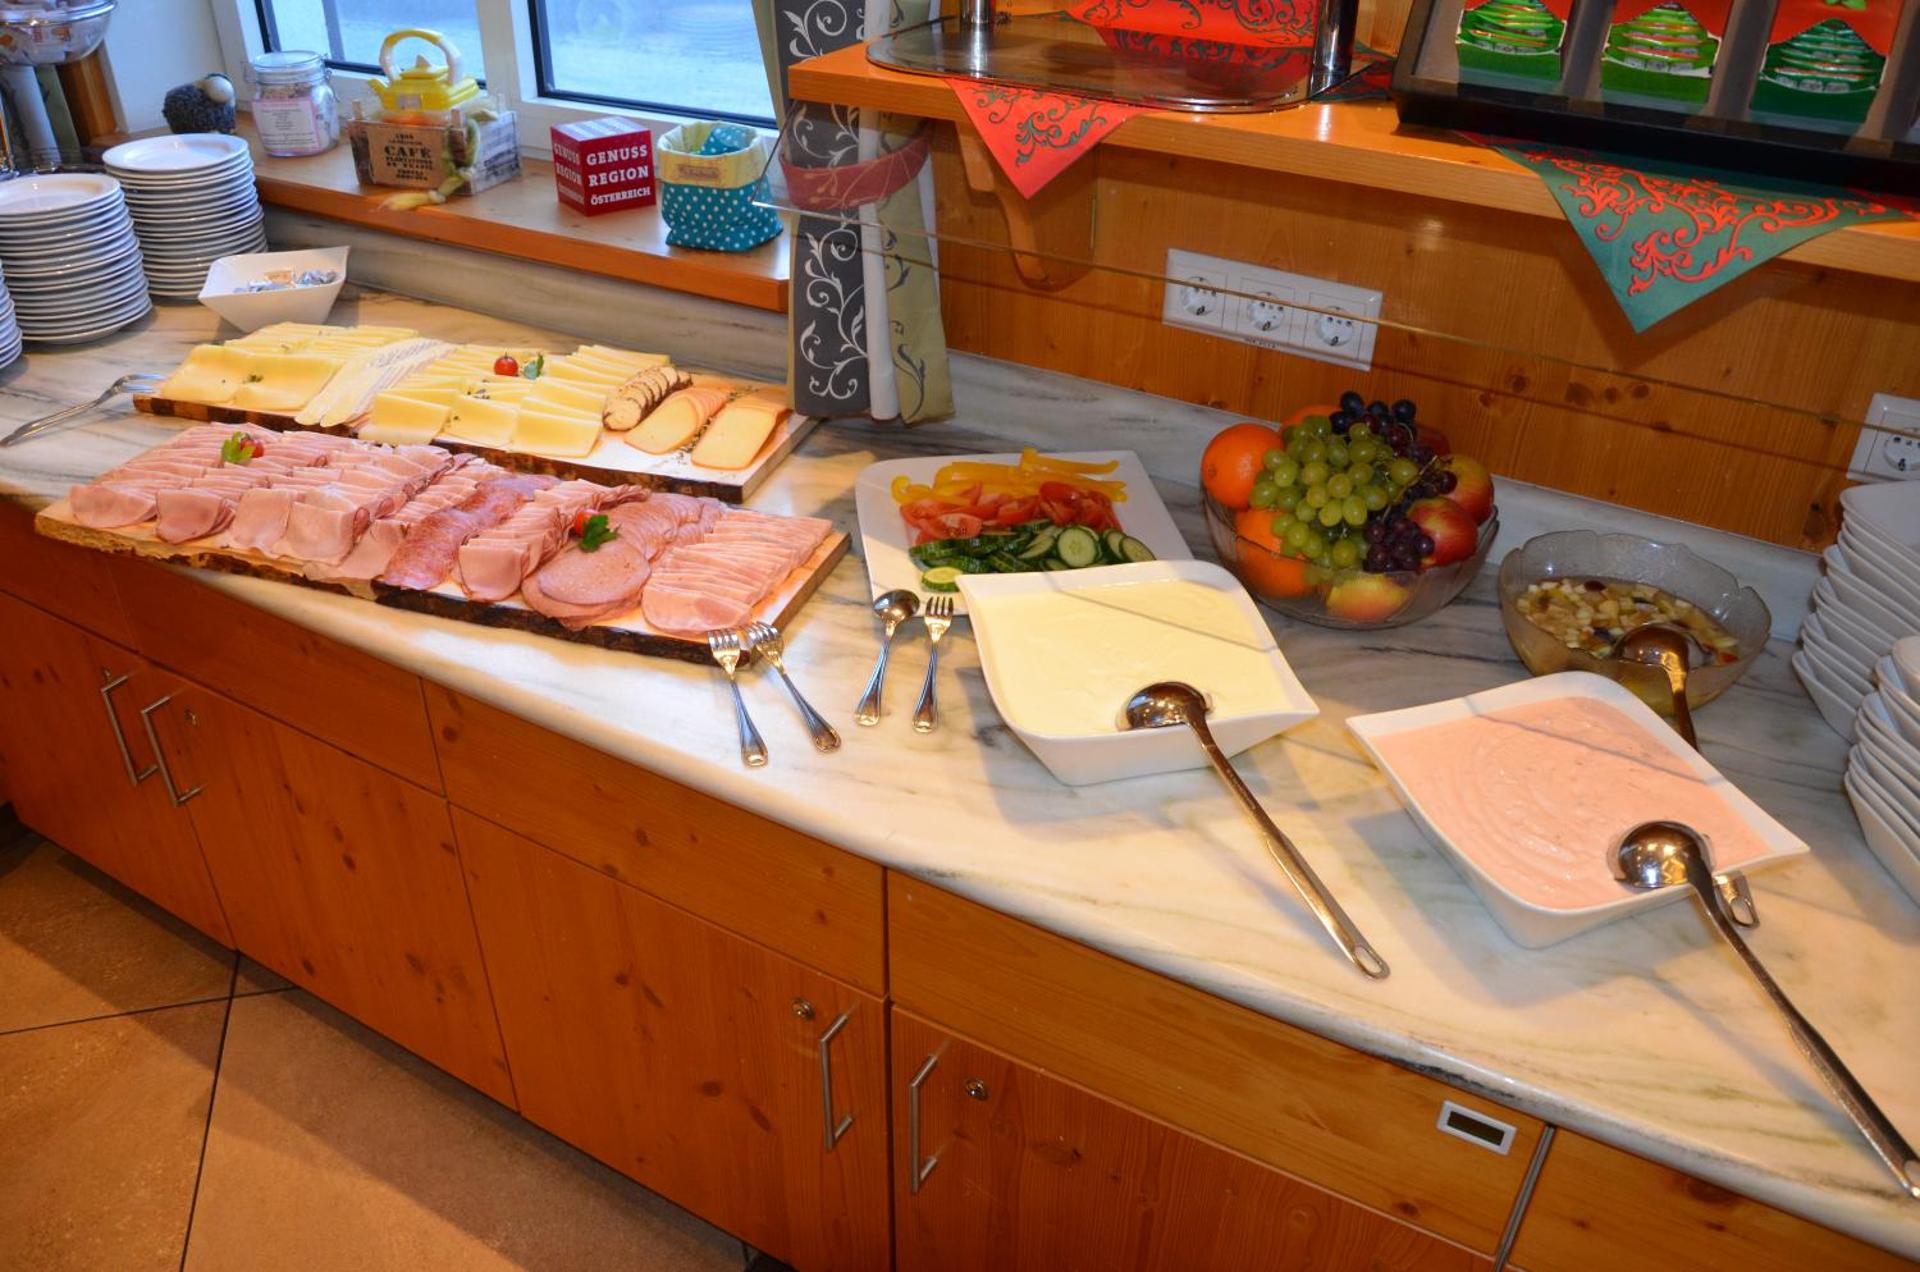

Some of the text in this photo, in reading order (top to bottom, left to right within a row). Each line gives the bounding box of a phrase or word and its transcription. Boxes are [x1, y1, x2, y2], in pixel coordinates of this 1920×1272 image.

[586, 144, 648, 166] GENUSS
[588, 165, 649, 187] REGION
[590, 186, 651, 206] ÖSTERREICH
